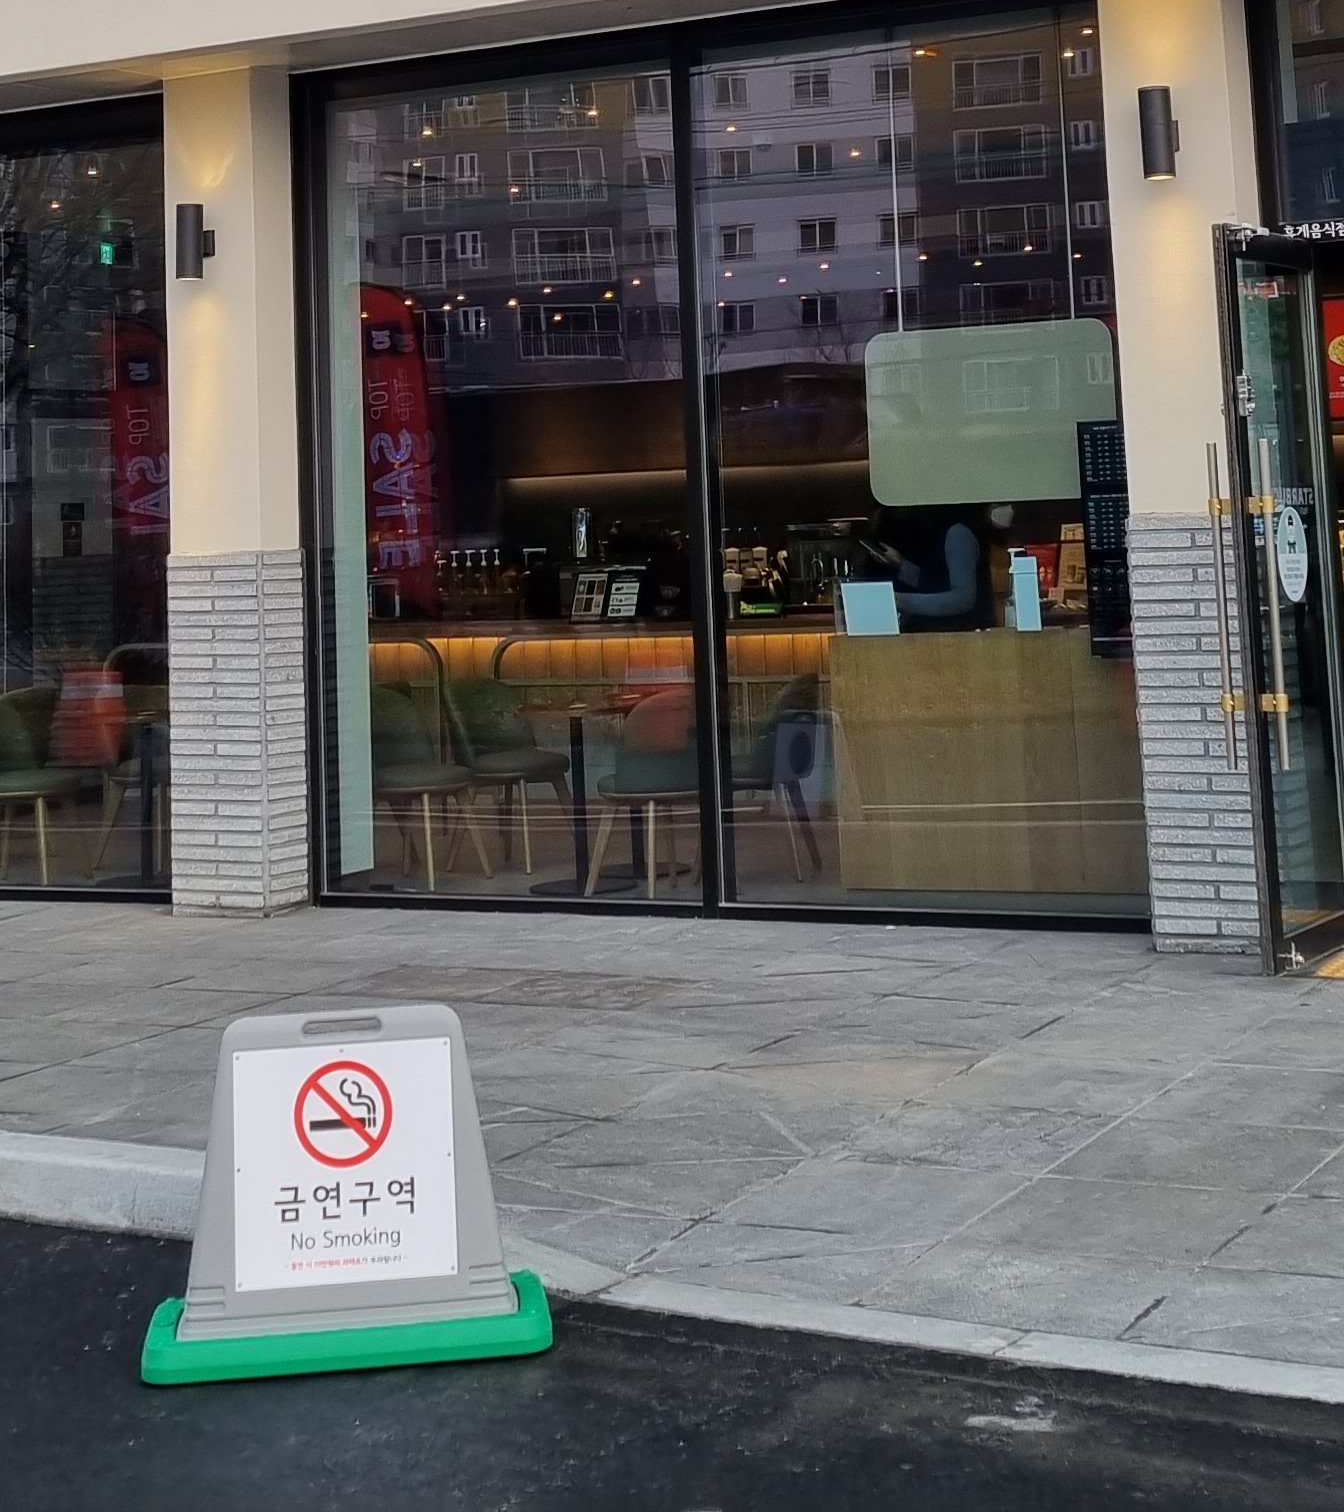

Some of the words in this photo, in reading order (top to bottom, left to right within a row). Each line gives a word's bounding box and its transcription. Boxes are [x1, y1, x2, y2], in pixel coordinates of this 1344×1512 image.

[274, 1176, 415, 1223] 금연구역
[291, 1232, 316, 1251] No
[323, 1226, 402, 1250] Smoking
